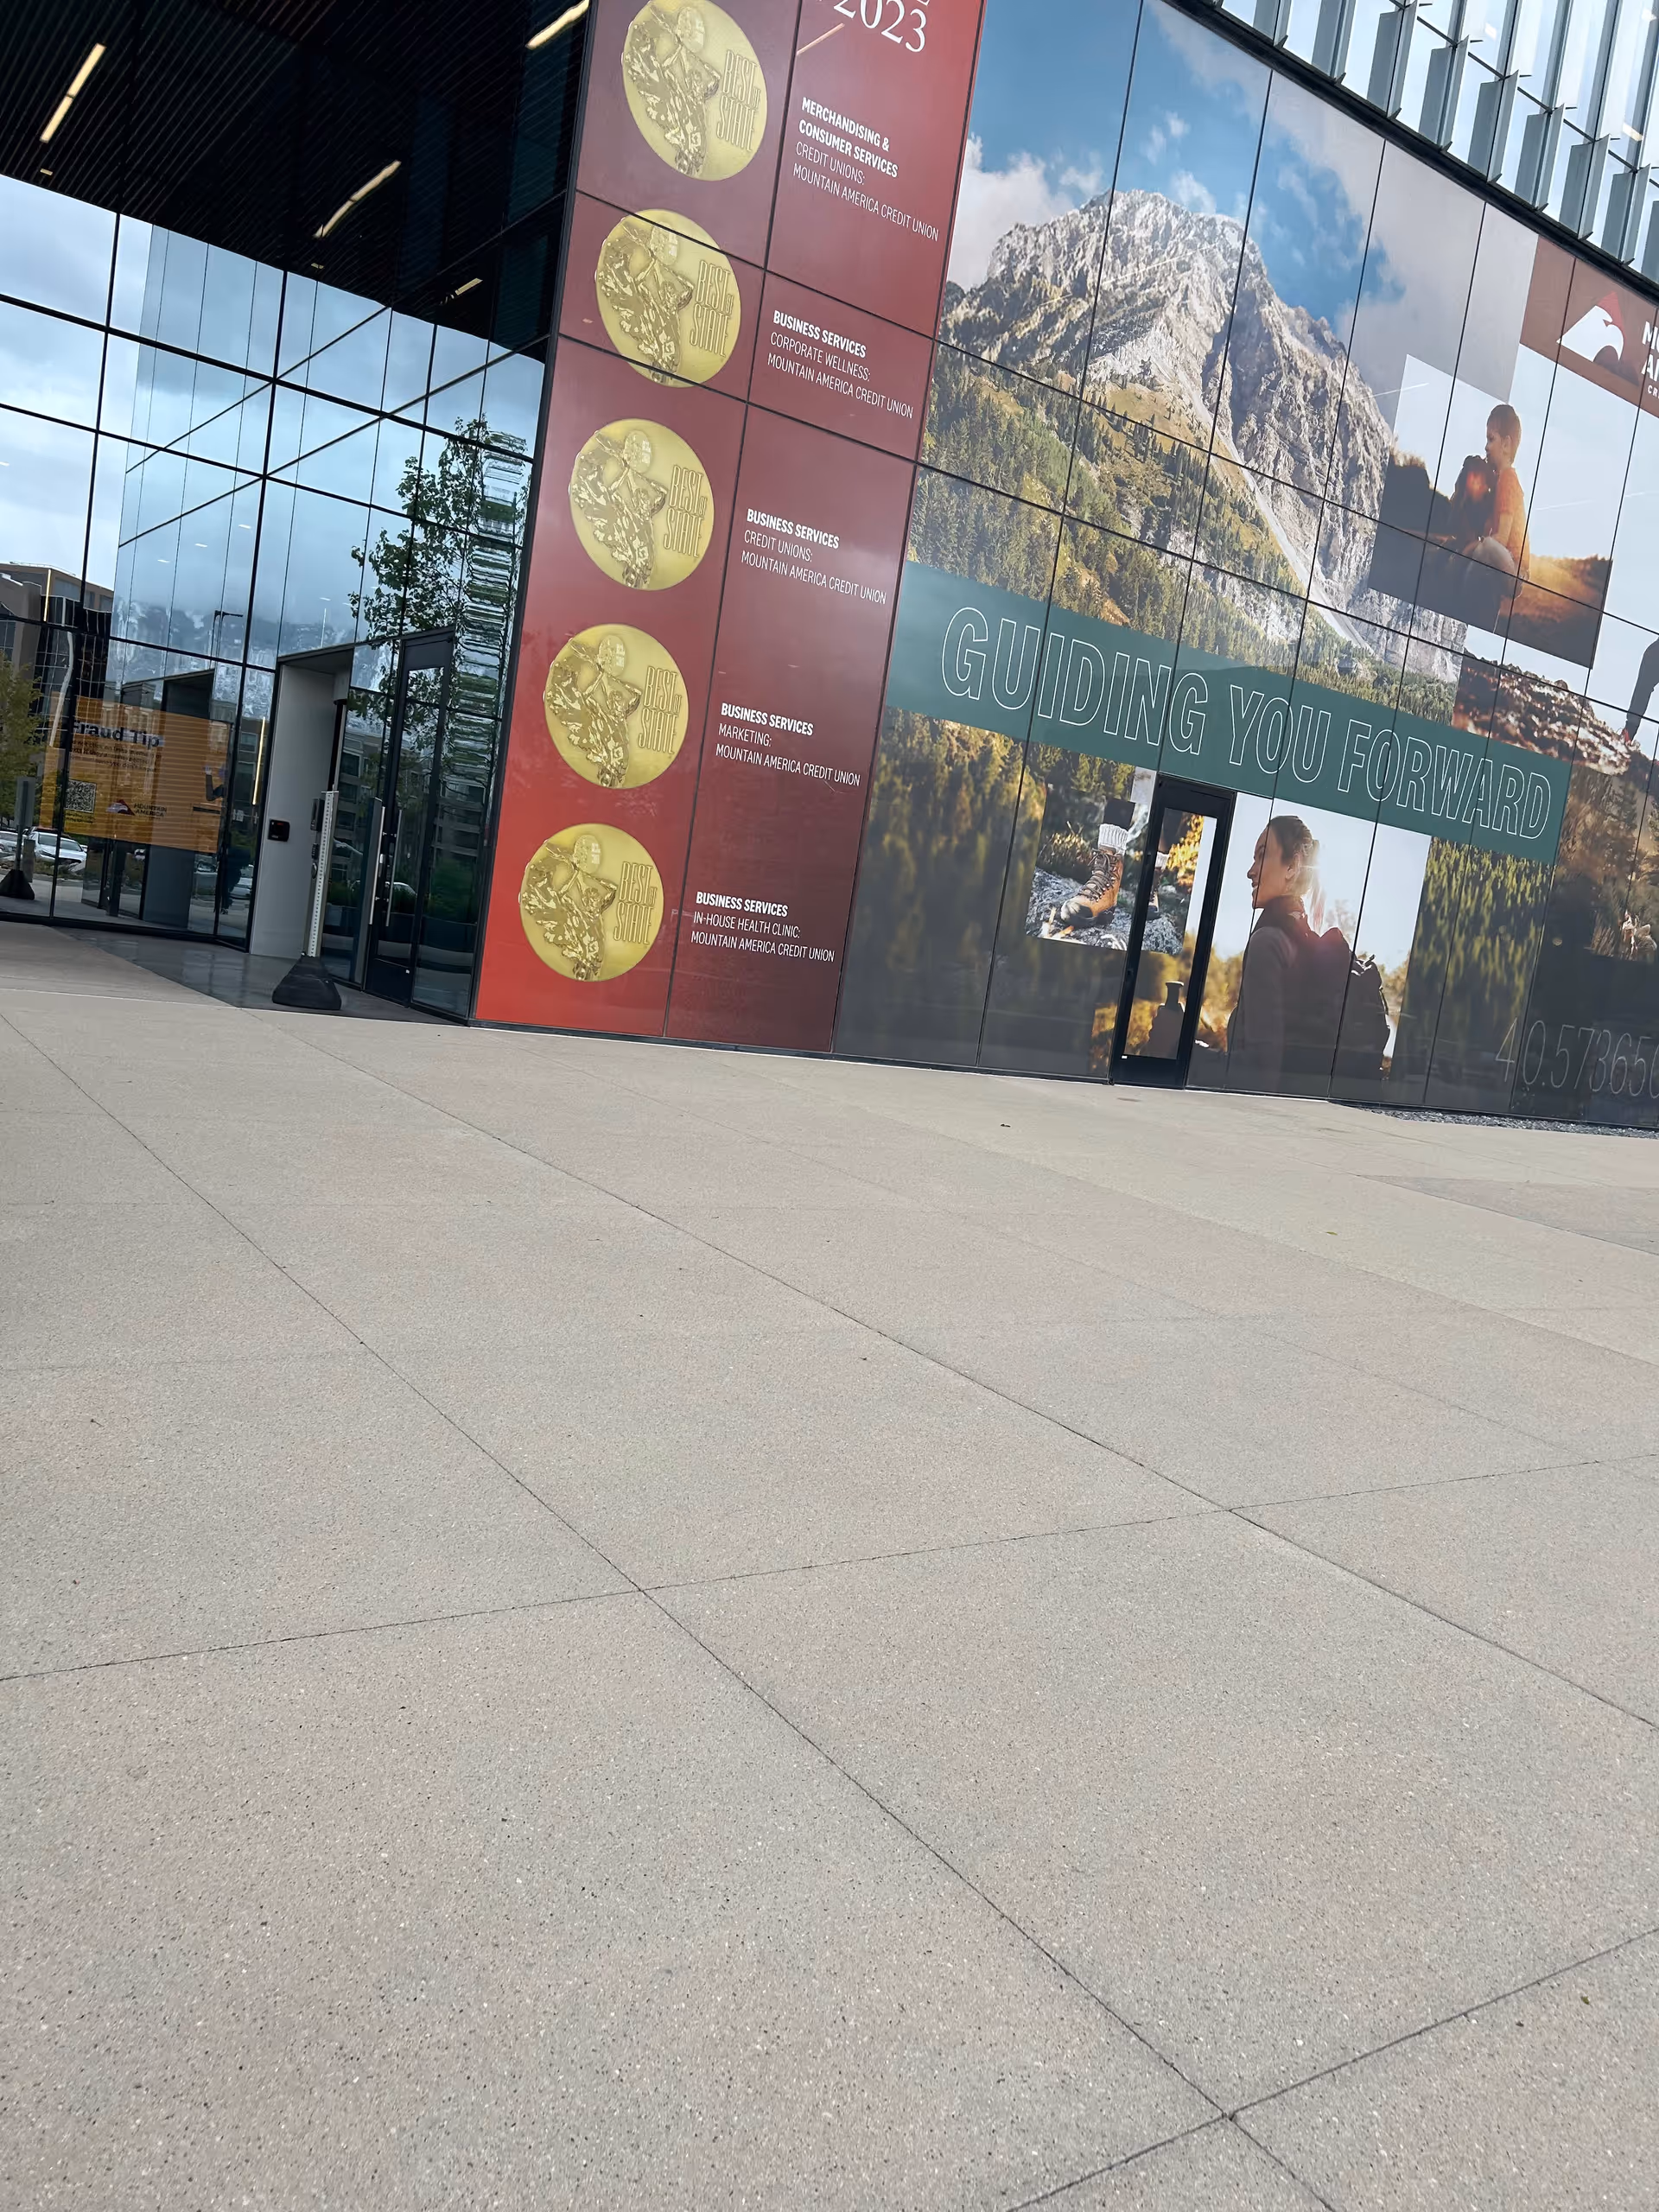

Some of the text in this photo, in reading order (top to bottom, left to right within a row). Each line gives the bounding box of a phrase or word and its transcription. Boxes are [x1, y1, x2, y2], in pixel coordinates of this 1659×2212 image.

[723, 49, 758, 105] BEST
[716, 95, 758, 152] STATE
[802, 97, 889, 152] MERCHANDISING &
[796, 142, 866, 186] CREDIT UNIONS:
[799, 119, 899, 178] CONSUMER SERVICES
[793, 162, 939, 242] MOUNTAIN AMERICA CREDIT UNION
[696, 260, 731, 311] BEST
[690, 303, 730, 358] STATE
[773, 310, 867, 359] BUSINESS SERVICES
[771, 332, 871, 382] CORPORATE WELLNESS:
[767, 353, 913, 419] MOUNTAIN AMERICA CREDIT UNION
[669, 464, 704, 515] BEST
[663, 507, 704, 559] STATE
[744, 530, 813, 563] CREDIT UNIONS:
[747, 508, 840, 550] BUSINESS SERVICES
[741, 550, 887, 605] MOUNTAIN AMERICA CREDIT UNION
[644, 665, 678, 712] BEST
[130, 729, 160, 750] Tip
[638, 707, 679, 755] STATE
[718, 722, 772, 747] MARKETING:
[721, 702, 814, 736] BUSINESS SERVICES
[942, 607, 1551, 840] GUIDING YOU FORWARD
[715, 743, 861, 786] MOUNTAIN AMERICA CREDIT UNION
[619, 861, 654, 904] BEST
[696, 891, 789, 918] BUSINESS SERVICES
[613, 901, 654, 945] STATE
[691, 931, 836, 963] MOUNTAIN AMERICA CREDIT UNION
[693, 911, 801, 938] IN-HOUSE HEALTH CLINIC:
